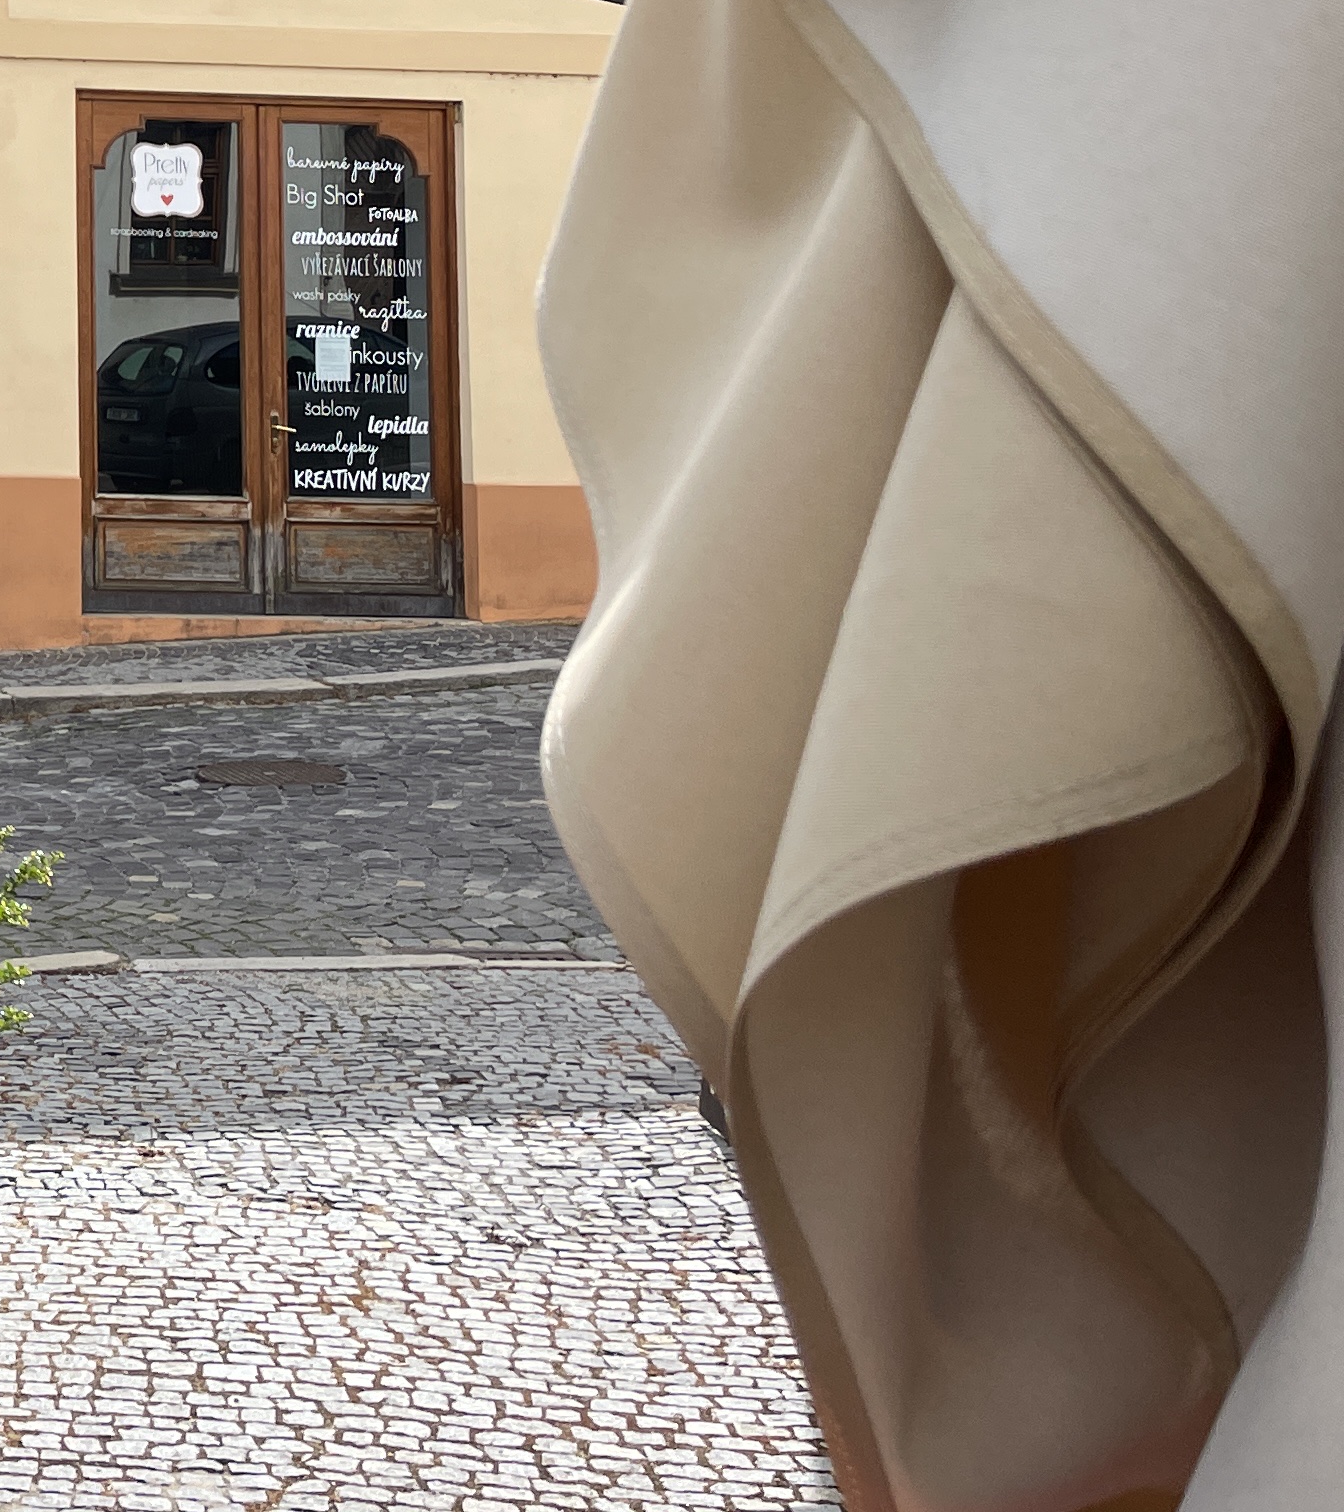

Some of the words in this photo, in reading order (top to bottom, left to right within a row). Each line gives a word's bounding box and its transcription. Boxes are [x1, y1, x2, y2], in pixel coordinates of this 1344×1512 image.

[286, 146, 350, 170] barevné
[350, 157, 405, 183] papíry
[286, 183, 317, 209] Big
[323, 184, 365, 206] Shot
[368, 206, 419, 224] FOTOALBA
[110, 227, 164, 239] scrapbooking
[165, 227, 172, 237] &
[173, 228, 219, 240] cardmaking
[291, 227, 400, 247] embossování
[301, 251, 370, 277] VYŘEZÁVACÍ
[373, 252, 423, 278] ŠABLONY
[292, 287, 324, 301] washi
[327, 288, 361, 305] pásky
[295, 320, 361, 339] raznice
[349, 341, 424, 371] inkousty
[354, 372, 361, 393] Z
[364, 369, 408, 395] PAPÍRU
[304, 399, 361, 421] šablony
[367, 415, 429, 439] lepidla
[295, 430, 380, 466] samolepky
[294, 466, 378, 492] KREATIVNÍ
[382, 471, 431, 493] KURZY
